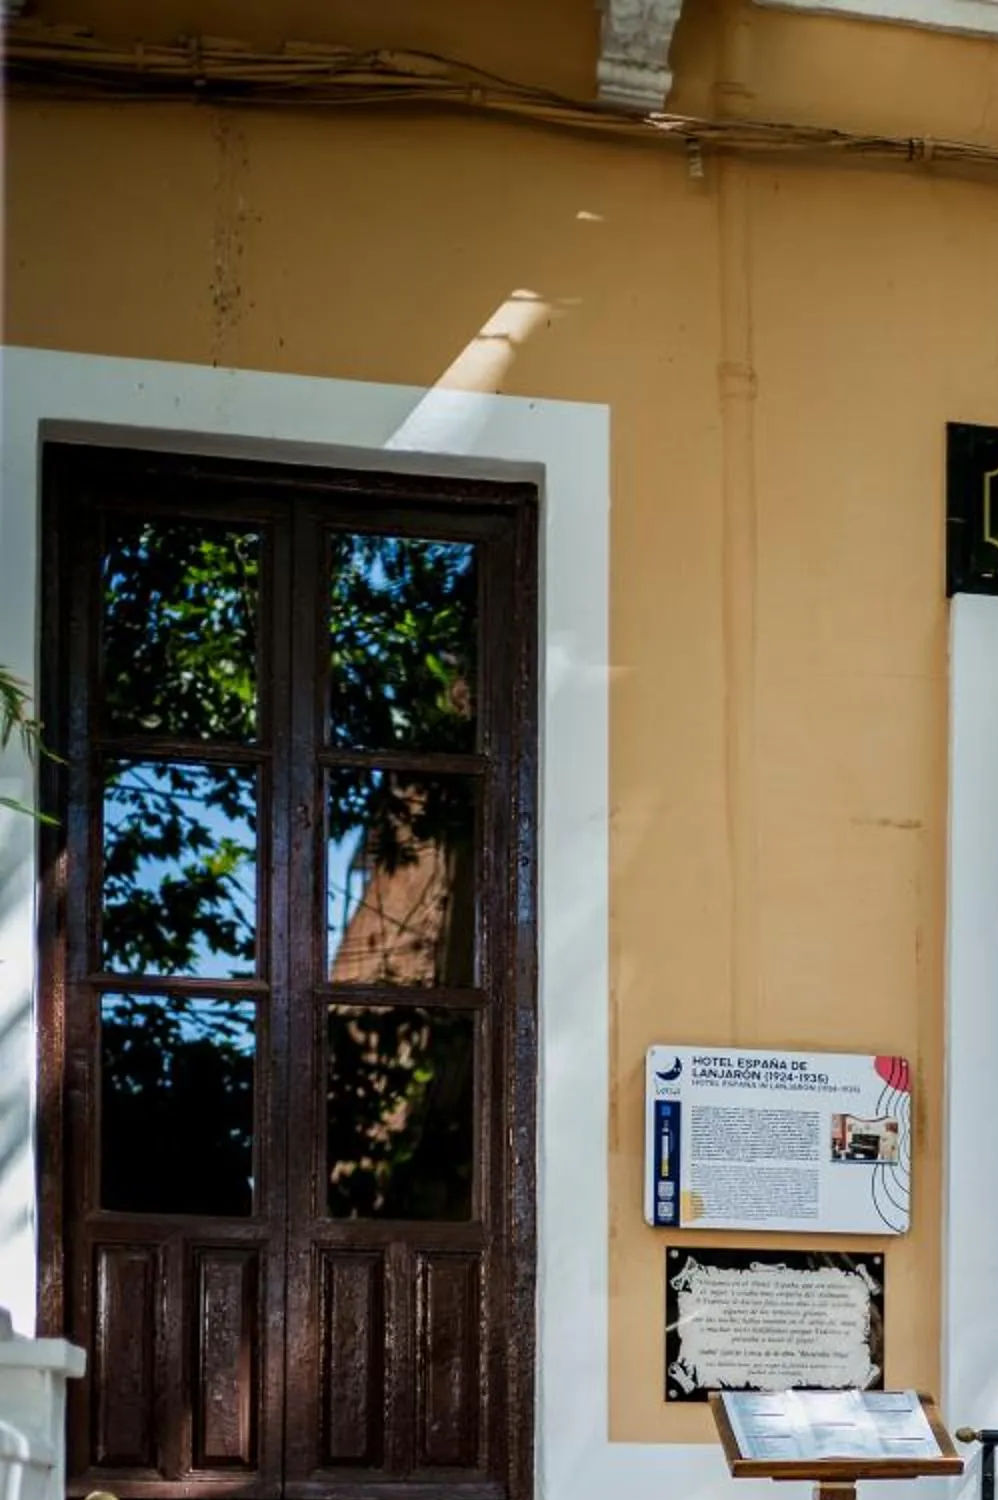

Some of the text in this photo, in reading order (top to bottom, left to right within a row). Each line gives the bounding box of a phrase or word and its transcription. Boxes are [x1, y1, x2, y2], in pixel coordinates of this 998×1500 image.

[692, 1056, 808, 1071] HOTEL ESPAÑA DE
[692, 1067, 761, 1080] LANJARÓN
